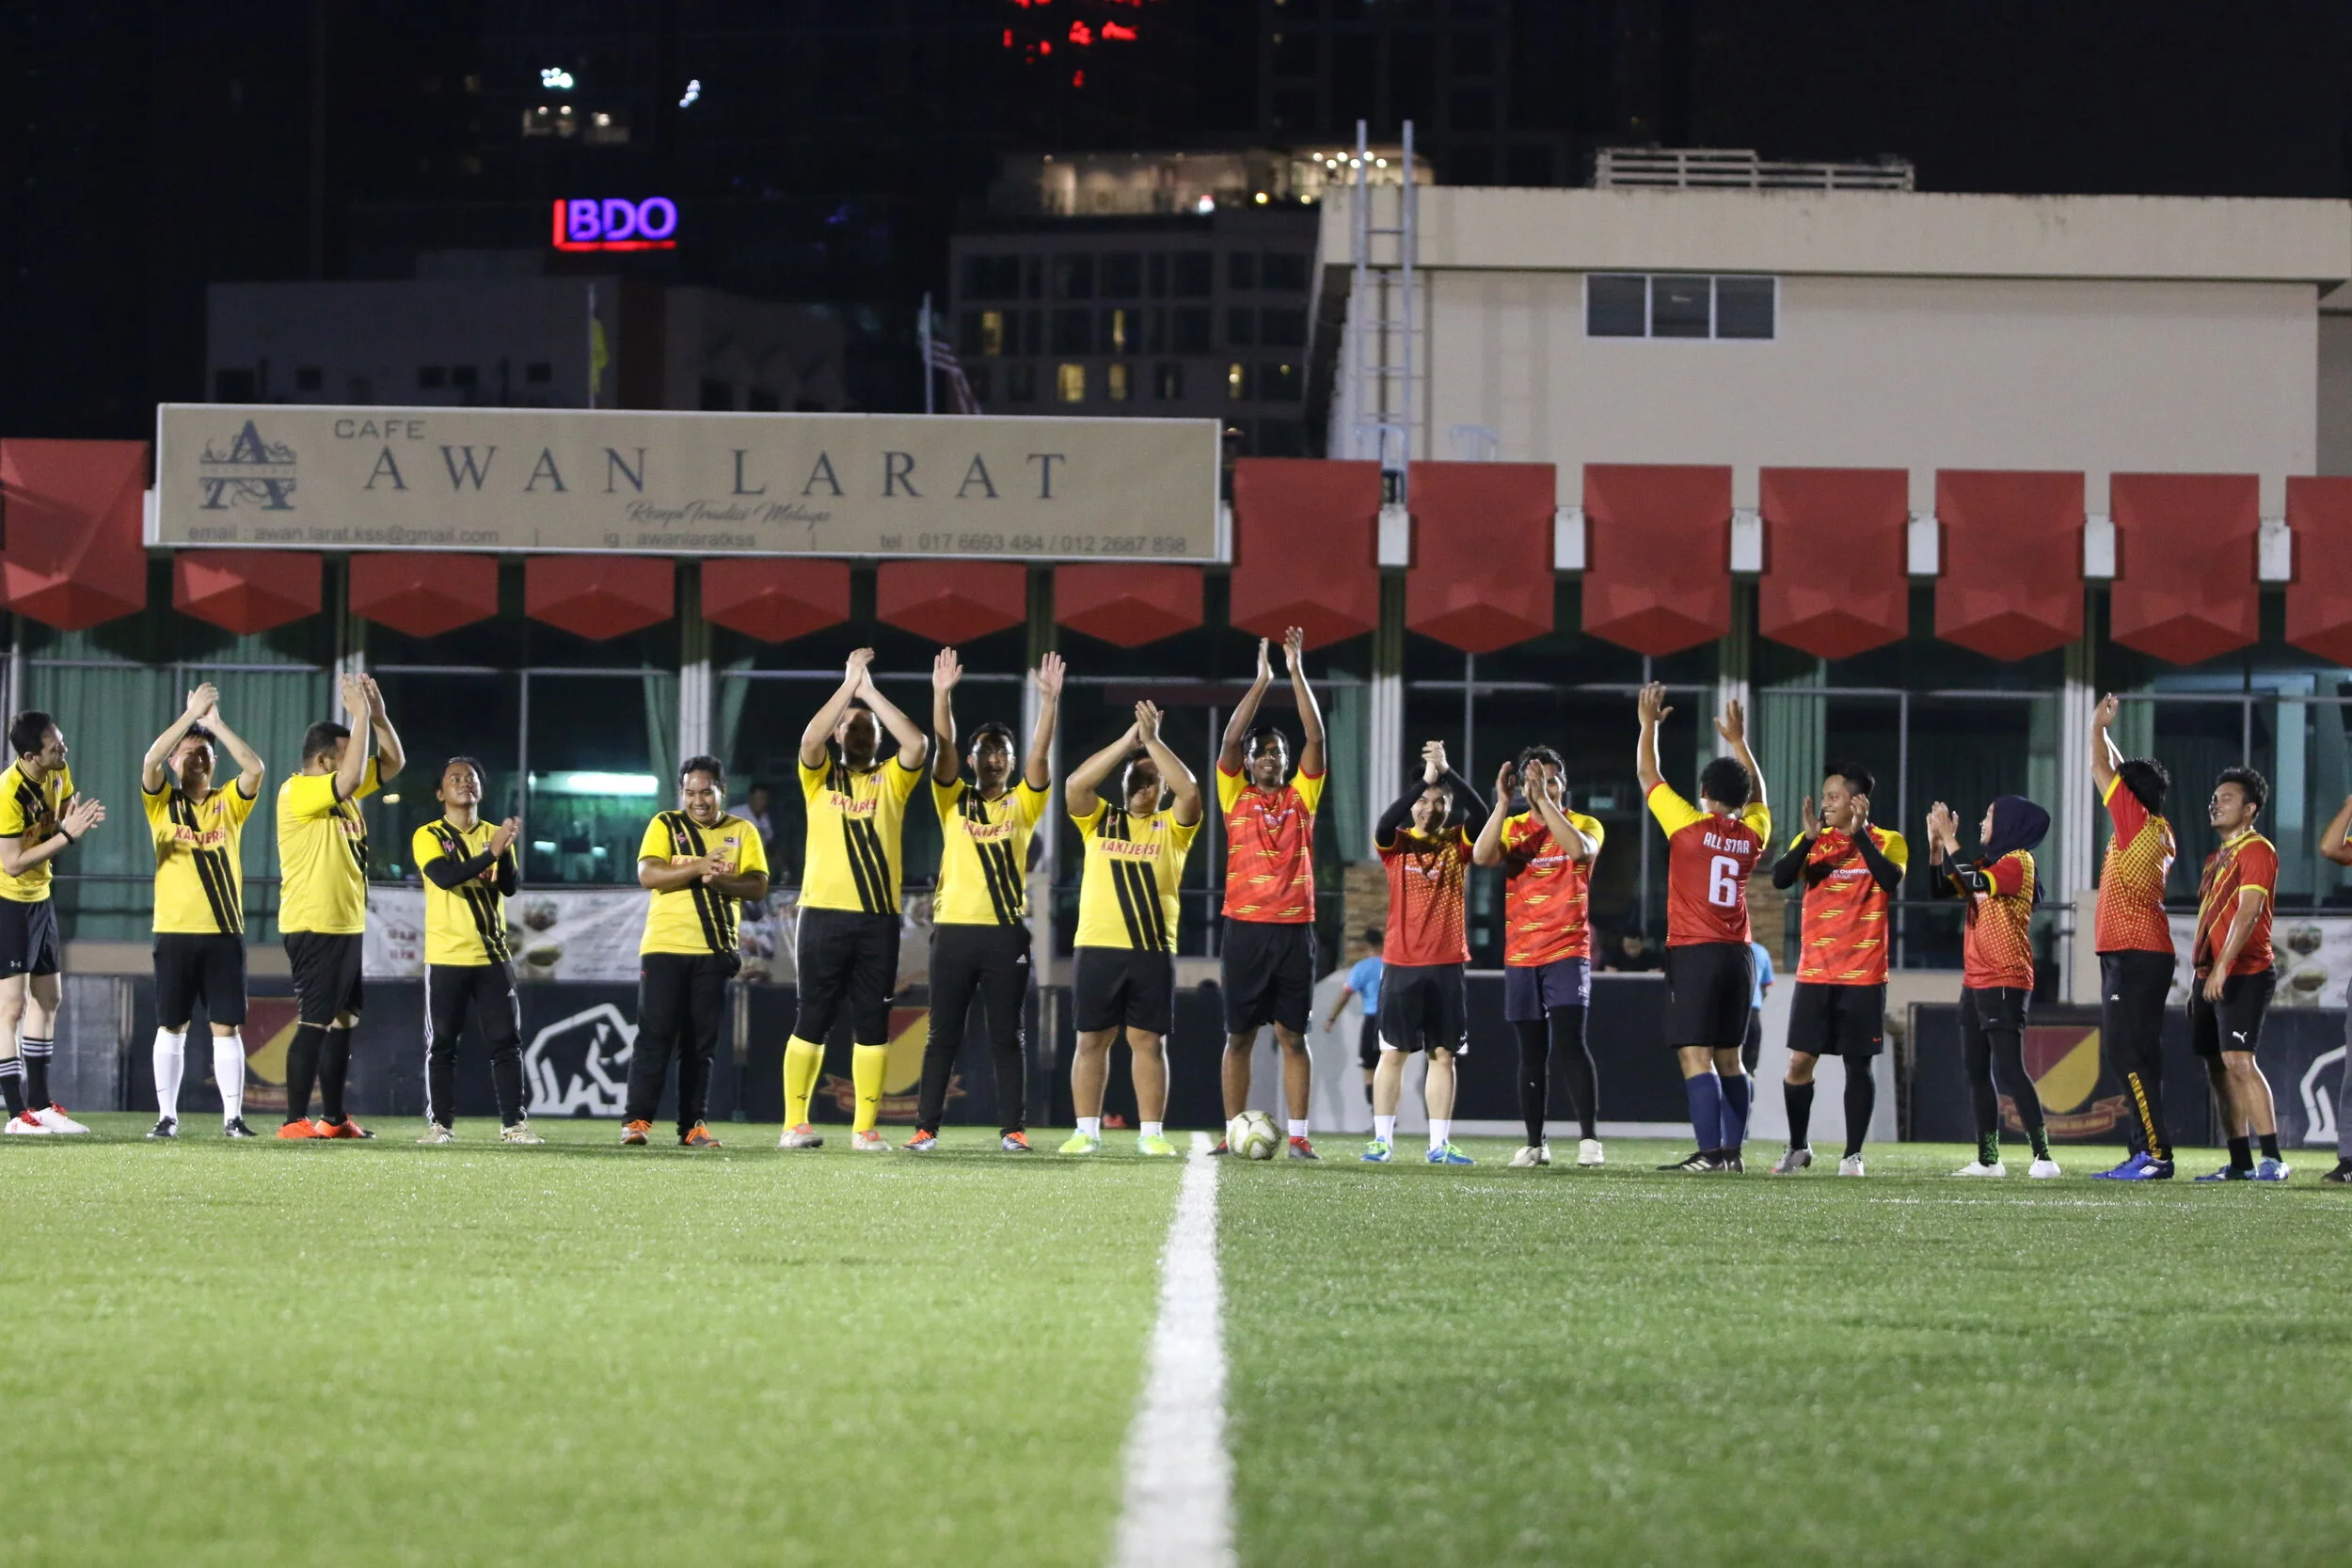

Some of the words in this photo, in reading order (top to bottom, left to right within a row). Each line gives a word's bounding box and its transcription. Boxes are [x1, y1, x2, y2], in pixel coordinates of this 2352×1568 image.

[568, 196, 676, 241] BDO
[334, 419, 426, 439] CAFE
[363, 445, 647, 493] AWAN
[731, 449, 1066, 499] LARAT
[188, 525, 237, 541] email
[603, 531, 620, 546] ig
[637, 531, 756, 547] awanlaratkss
[880, 533, 901, 548] tel
[918, 533, 953, 549] 017
[1060, 535, 1095, 552] 012
[1703, 832, 1722, 849] ALL
[1724, 838, 1750, 854] STAR
[1708, 855, 1740, 908] 6
